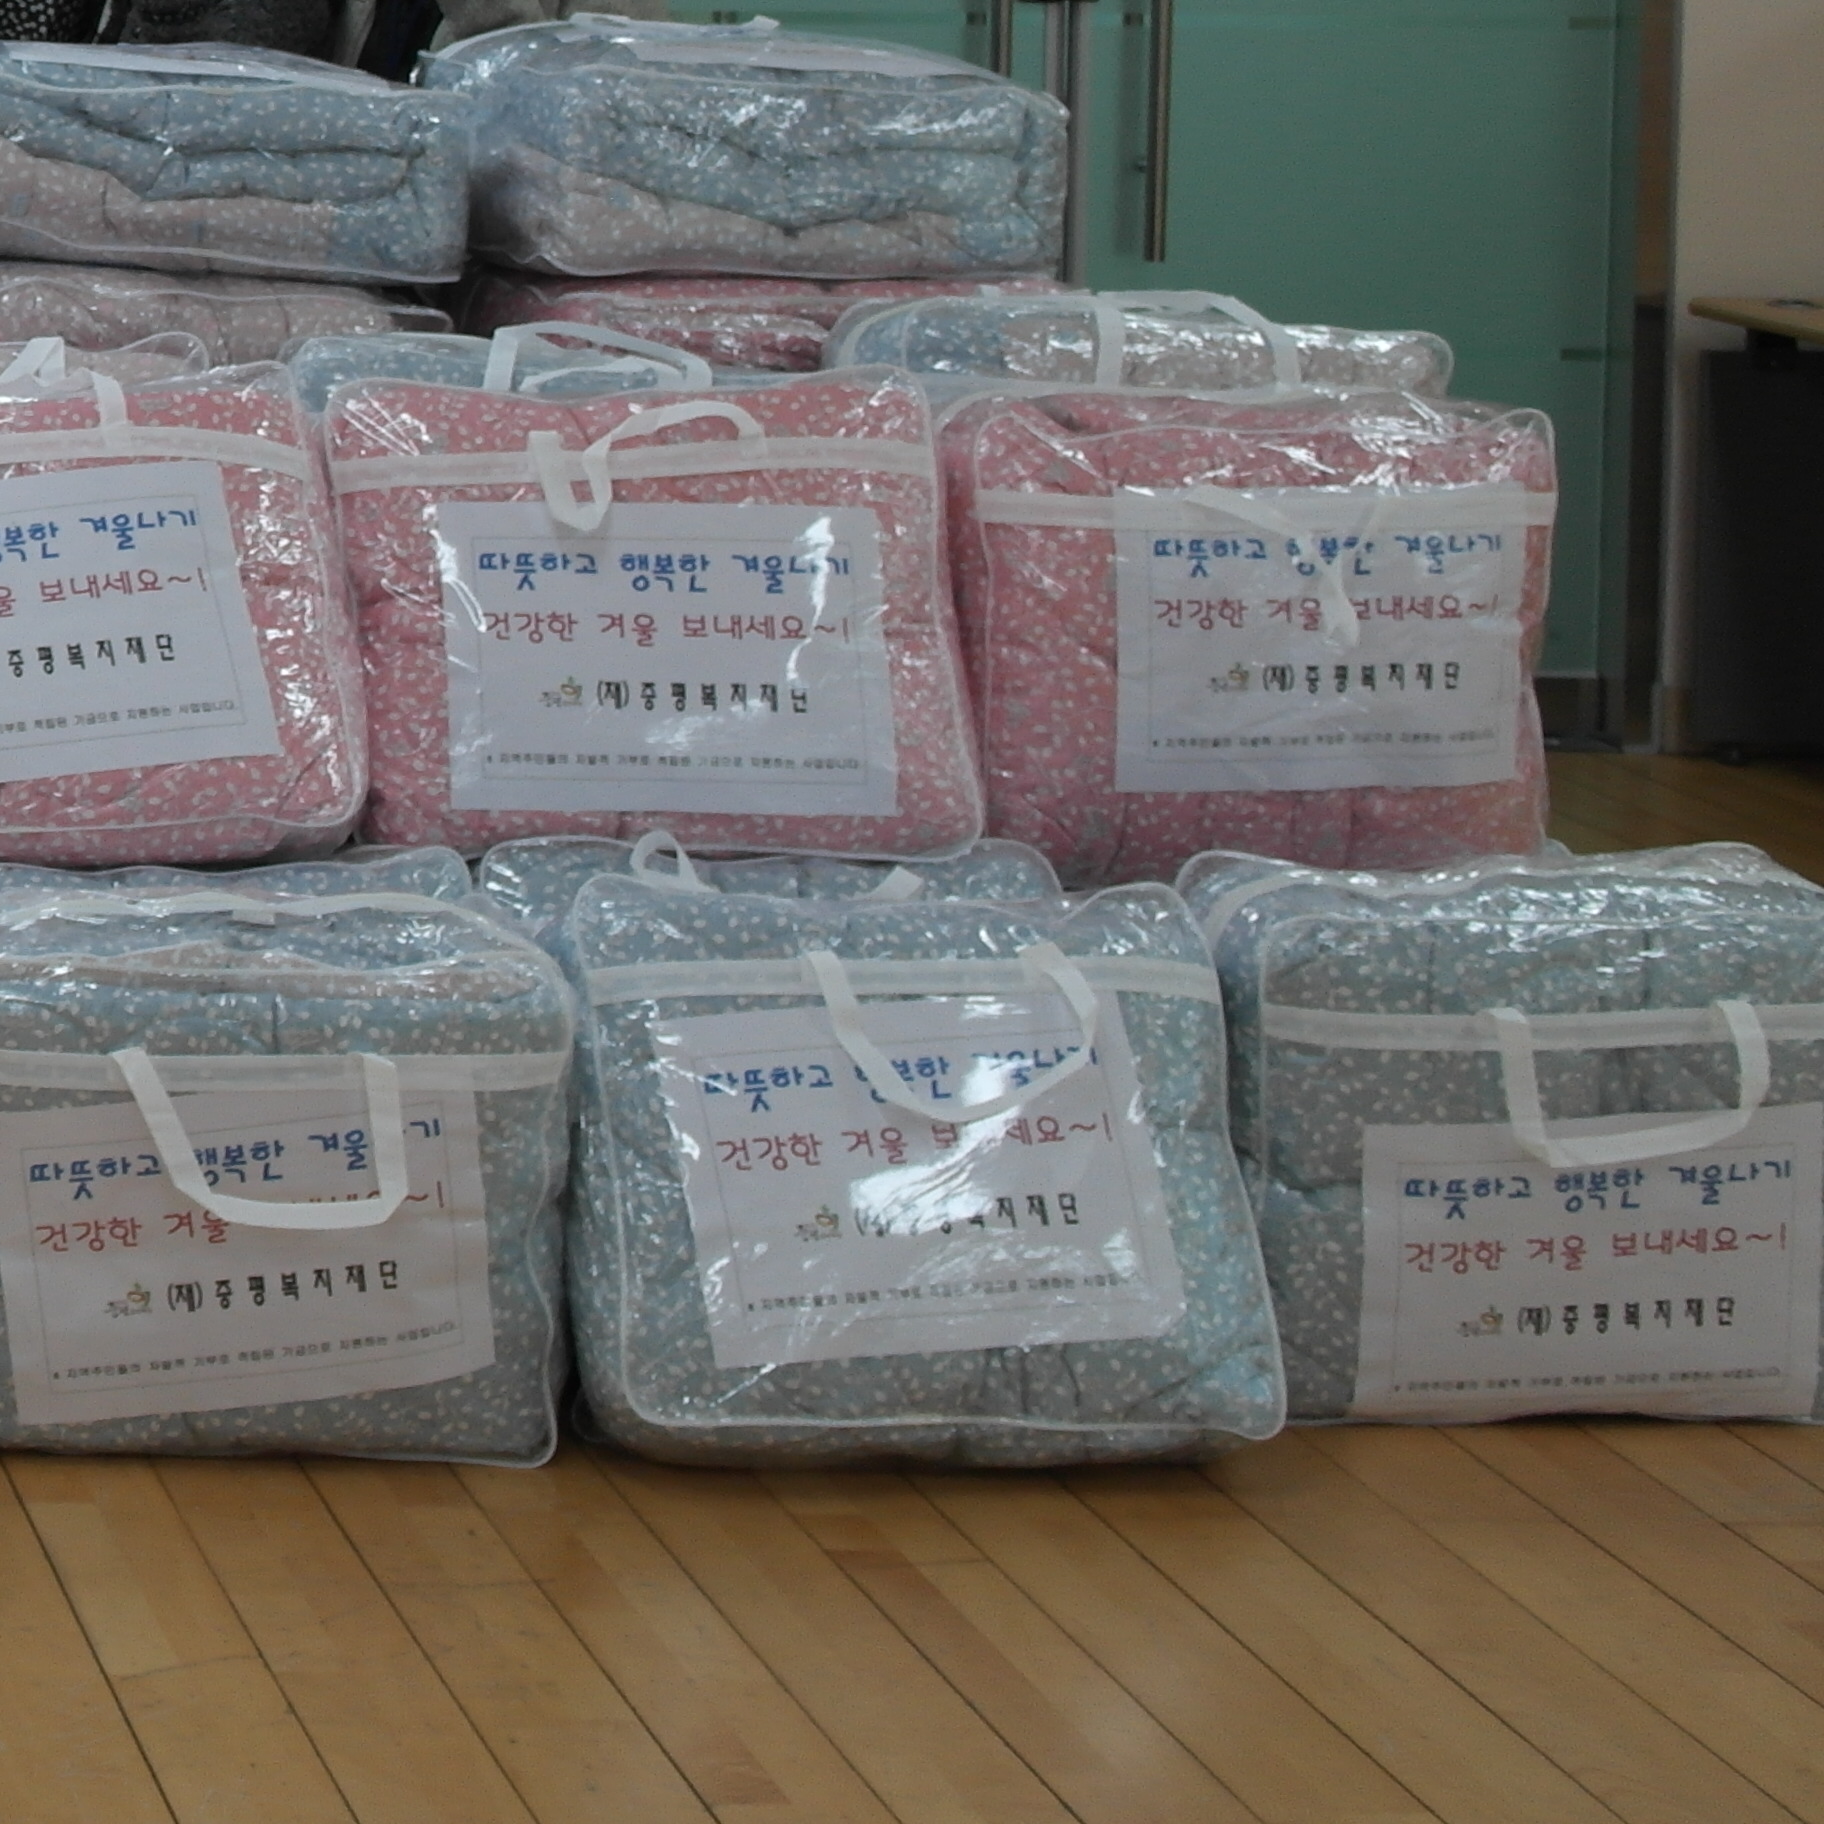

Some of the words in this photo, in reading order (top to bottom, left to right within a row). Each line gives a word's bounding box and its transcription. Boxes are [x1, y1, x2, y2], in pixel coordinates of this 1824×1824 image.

[79, 510, 197, 550] 겨울나기
[479, 553, 597, 591] 따뜻하고
[619, 553, 710, 592] 행복한
[1154, 537, 1267, 577] 따뜻하고
[1395, 535, 1501, 574] 겨울나기
[39, 567, 208, 604] 보내세요~!
[483, 611, 578, 643] 건강한
[597, 613, 658, 647] 겨울
[682, 613, 850, 643] 보내세요~!
[1154, 599, 1248, 630] 건강한
[1266, 599, 1322, 631] 겨울
[703, 1064, 833, 1112] 따뜻하고
[29, 1153, 161, 1200] 따뜻하고
[194, 1141, 284, 1186] 행복한
[308, 1117, 441, 1171] 겨울기
[716, 1132, 823, 1171] 건강한
[841, 1126, 908, 1164] 겨울
[933, 1113, 1115, 1151] 보세요~!
[1405, 1178, 1533, 1220] 따뜻하고
[1555, 1169, 1644, 1213] 행복한
[1669, 1161, 1791, 1205] 겨울나기
[35, 1216, 142, 1252] 건강한
[162, 1210, 230, 1245] 겨울
[1404, 1240, 1506, 1275] 건강한
[1525, 1235, 1586, 1272] 겨울
[1611, 1223, 1787, 1259] 보내세요~!
